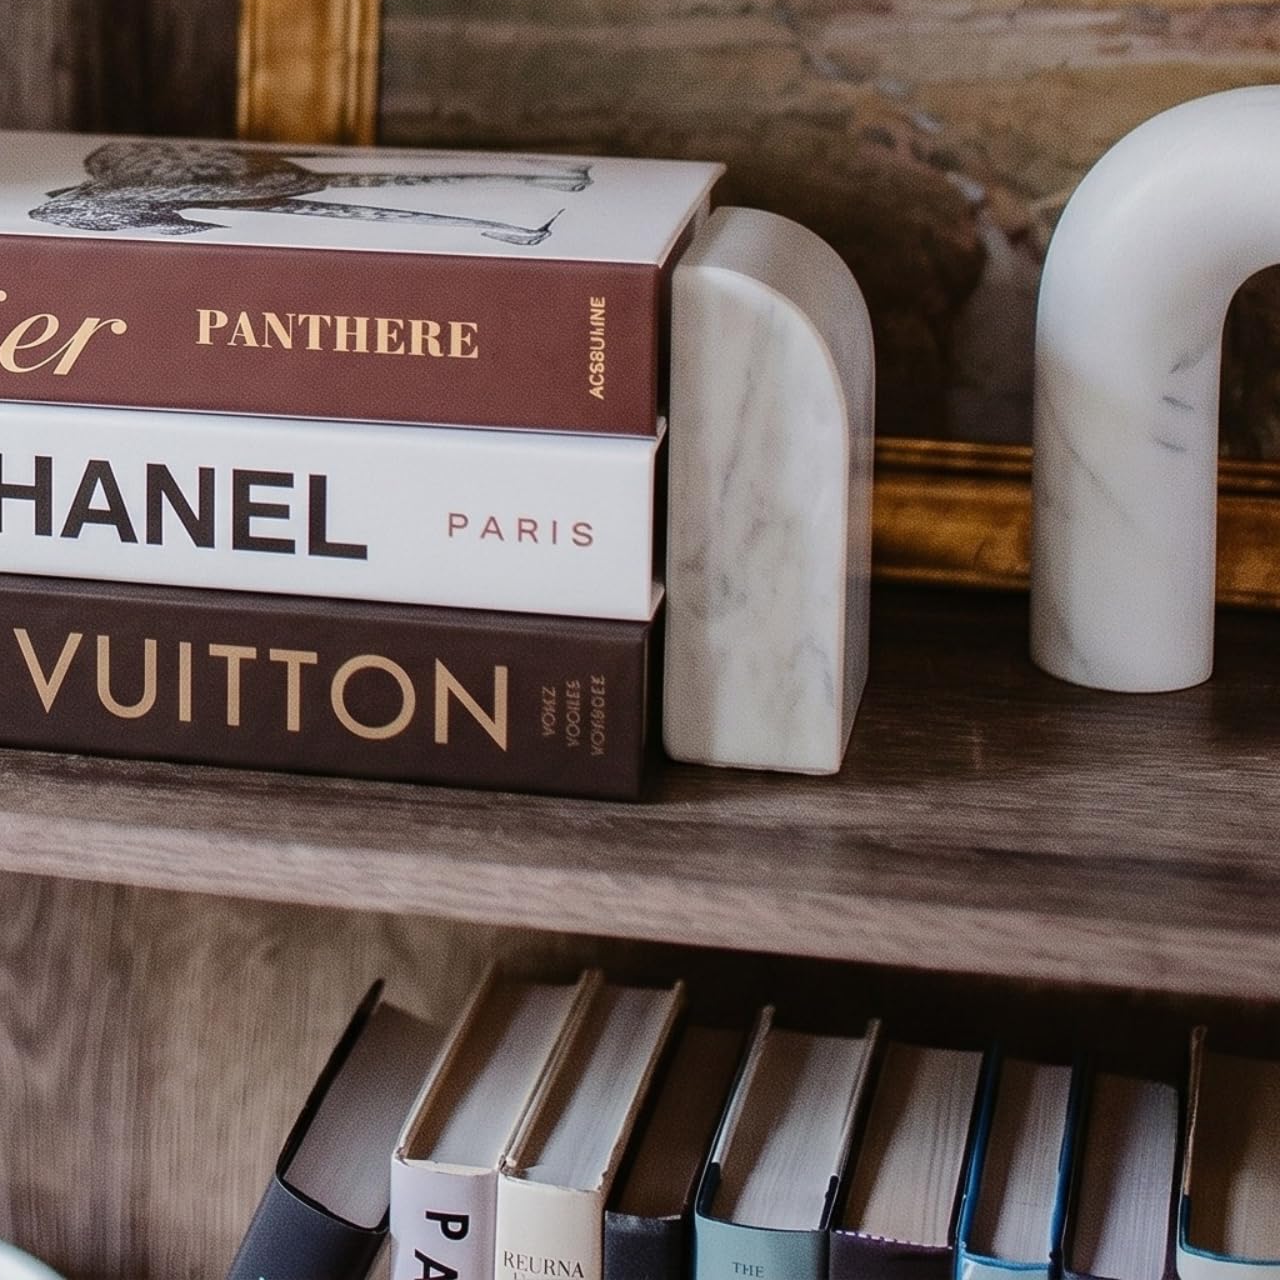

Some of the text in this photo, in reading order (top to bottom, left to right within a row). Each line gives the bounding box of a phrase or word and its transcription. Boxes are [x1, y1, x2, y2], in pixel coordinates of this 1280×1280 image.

[196, 309, 479, 359] PANTHERE
[447, 512, 594, 547] PARIS
[12, 627, 508, 752] VUITTON
[732, 1262, 764, 1278] THE
